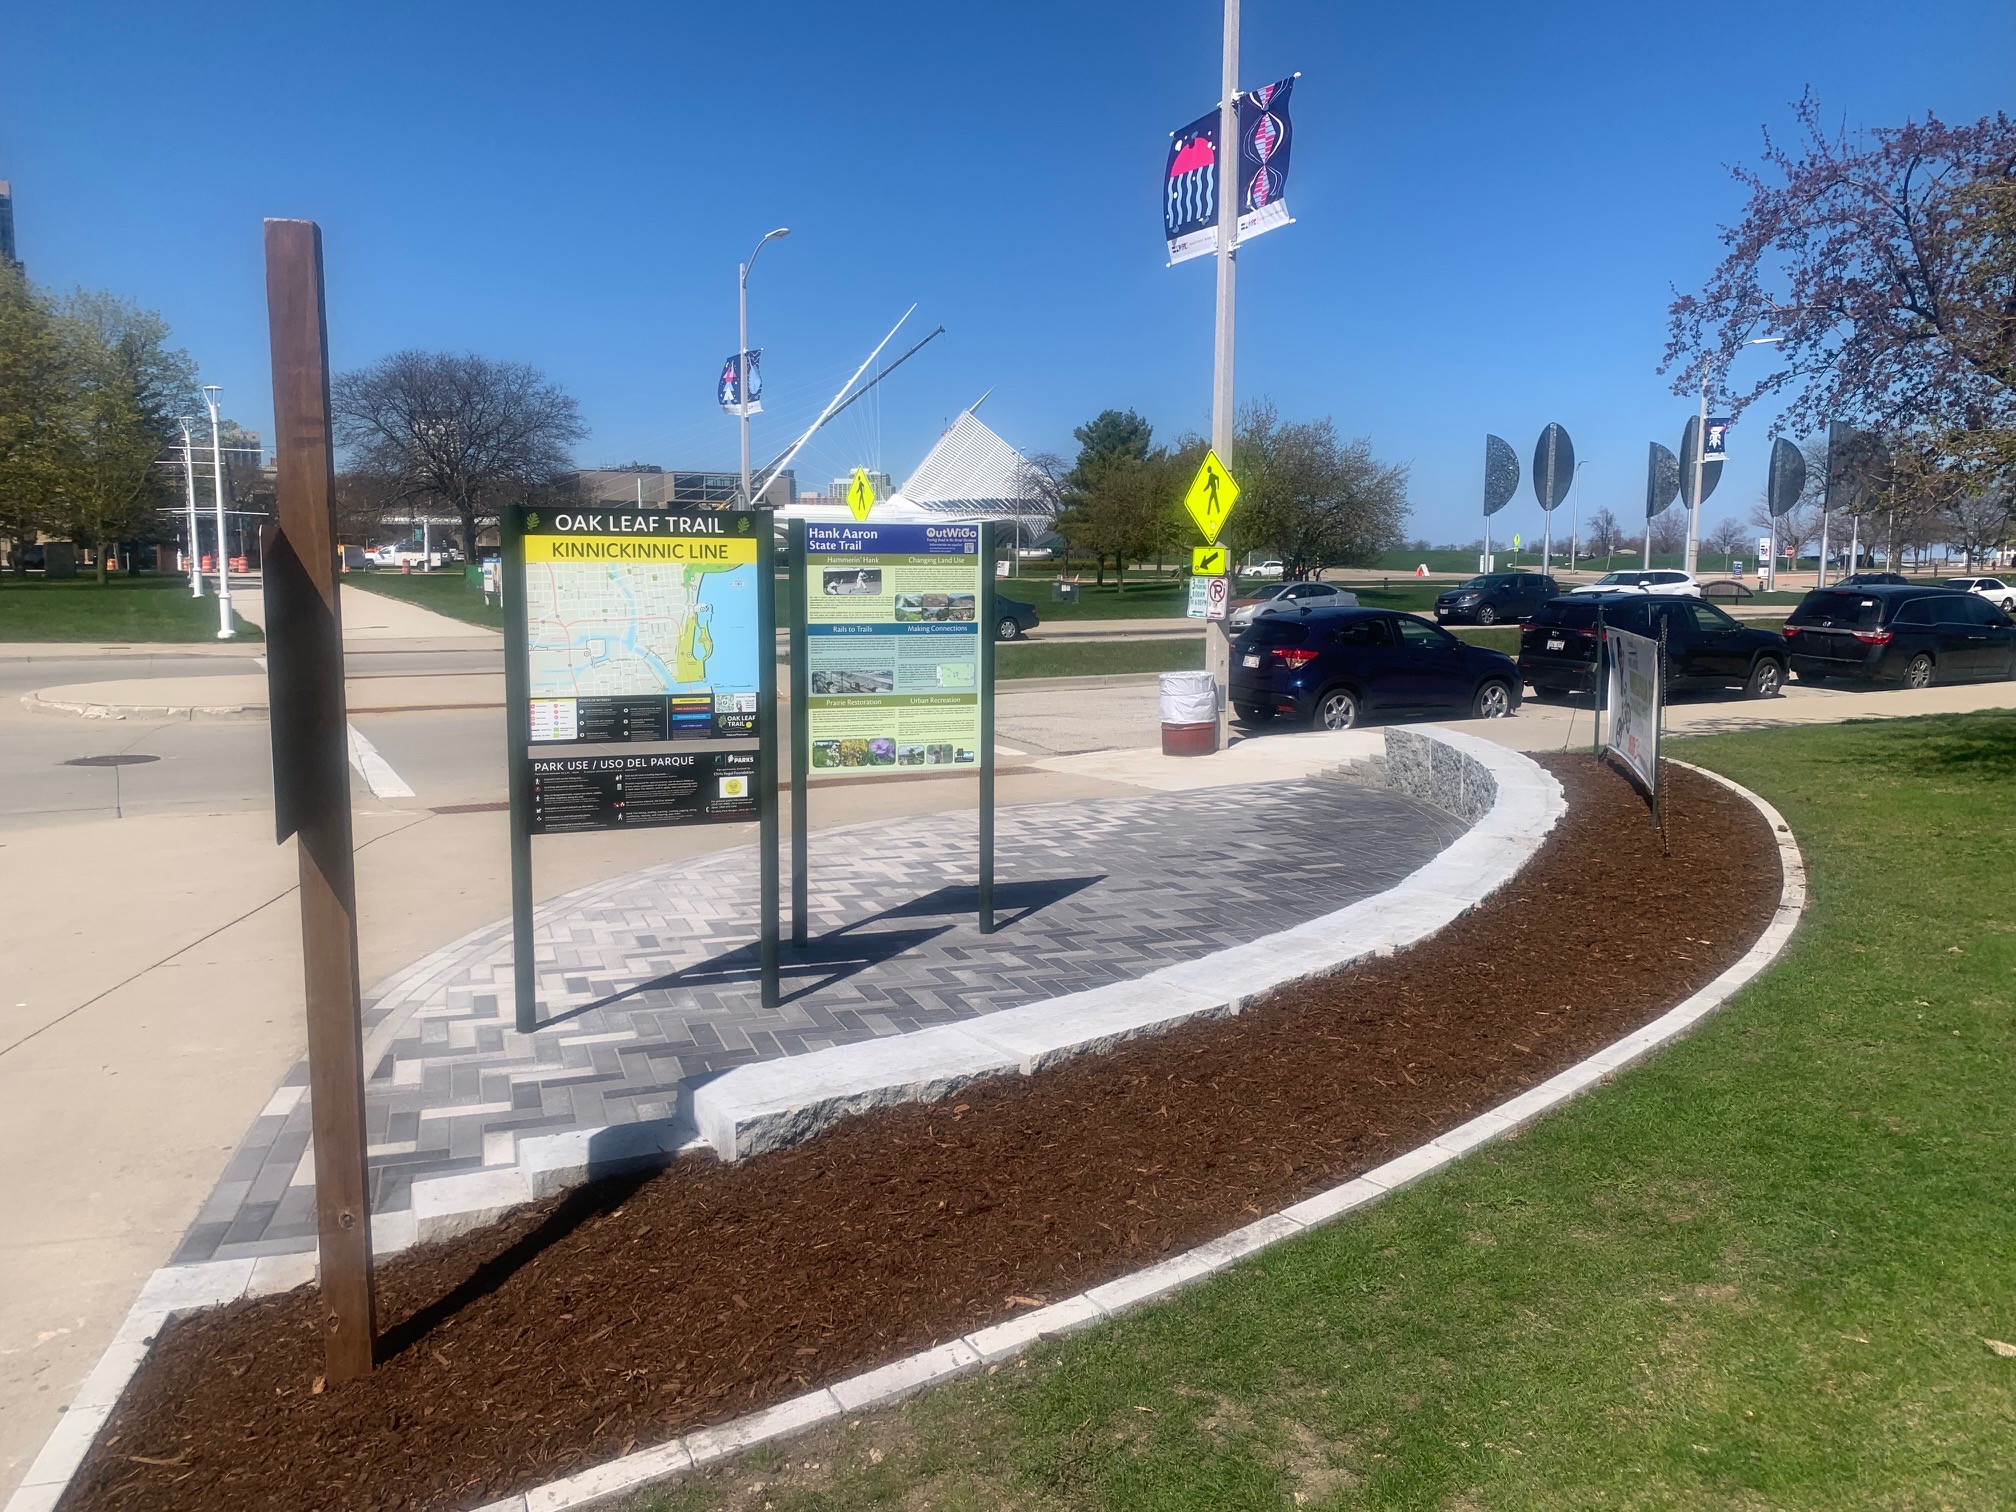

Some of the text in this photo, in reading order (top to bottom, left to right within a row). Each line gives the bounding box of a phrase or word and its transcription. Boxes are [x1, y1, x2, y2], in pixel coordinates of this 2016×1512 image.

[555, 514, 725, 534] OAK LEAF TRAIL
[809, 527, 878, 540] Hank Aaron
[926, 527, 977, 538] OutWiGo
[552, 542, 729, 560] KINNICKINNIC LINE
[809, 540, 862, 550] State Trail
[908, 556, 936, 565] Changing
[534, 756, 695, 772] PARK USE / USO DEL PARQUE
